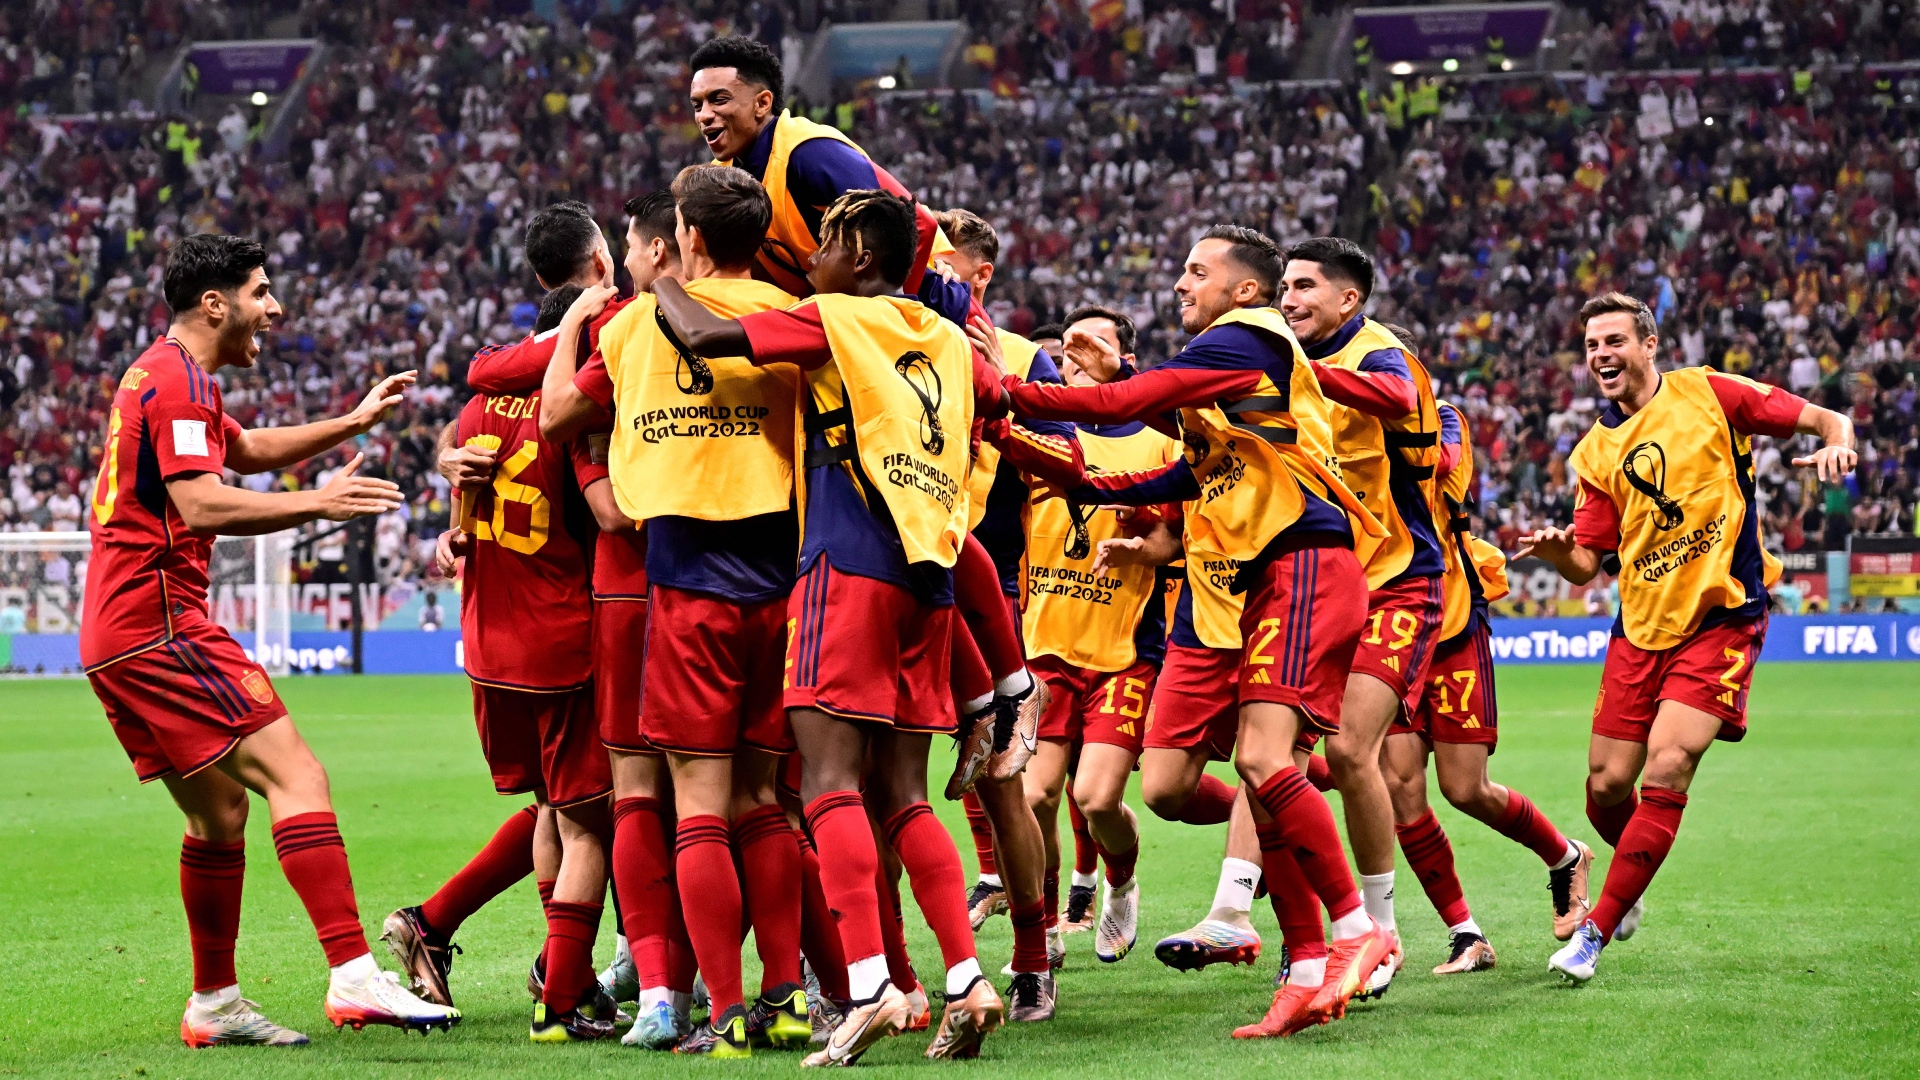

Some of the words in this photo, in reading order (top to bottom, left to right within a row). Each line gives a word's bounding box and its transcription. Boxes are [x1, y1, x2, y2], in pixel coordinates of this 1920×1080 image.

[633, 409, 668, 430] FIFA
[669, 405, 731, 419] WORLD
[734, 405, 769, 420] CUP
[642, 421, 760, 444] Qatar2022
[883, 453, 913, 470] FIFA
[913, 458, 948, 486] WORLD
[1203, 561, 1227, 572] FIFA
[1633, 551, 1661, 572] FIFA
[1659, 529, 1704, 558] WORLD
[1029, 565, 1050, 579] IFA
[1050, 567, 1095, 585] WORLD
[1096, 576, 1122, 590] CUP
[1364, 609, 1418, 651] 19
[1804, 625, 1878, 654] FIFA
[1719, 647, 1745, 692] 2
[1099, 677, 1146, 719] 15
[1434, 670, 1477, 714] 17
